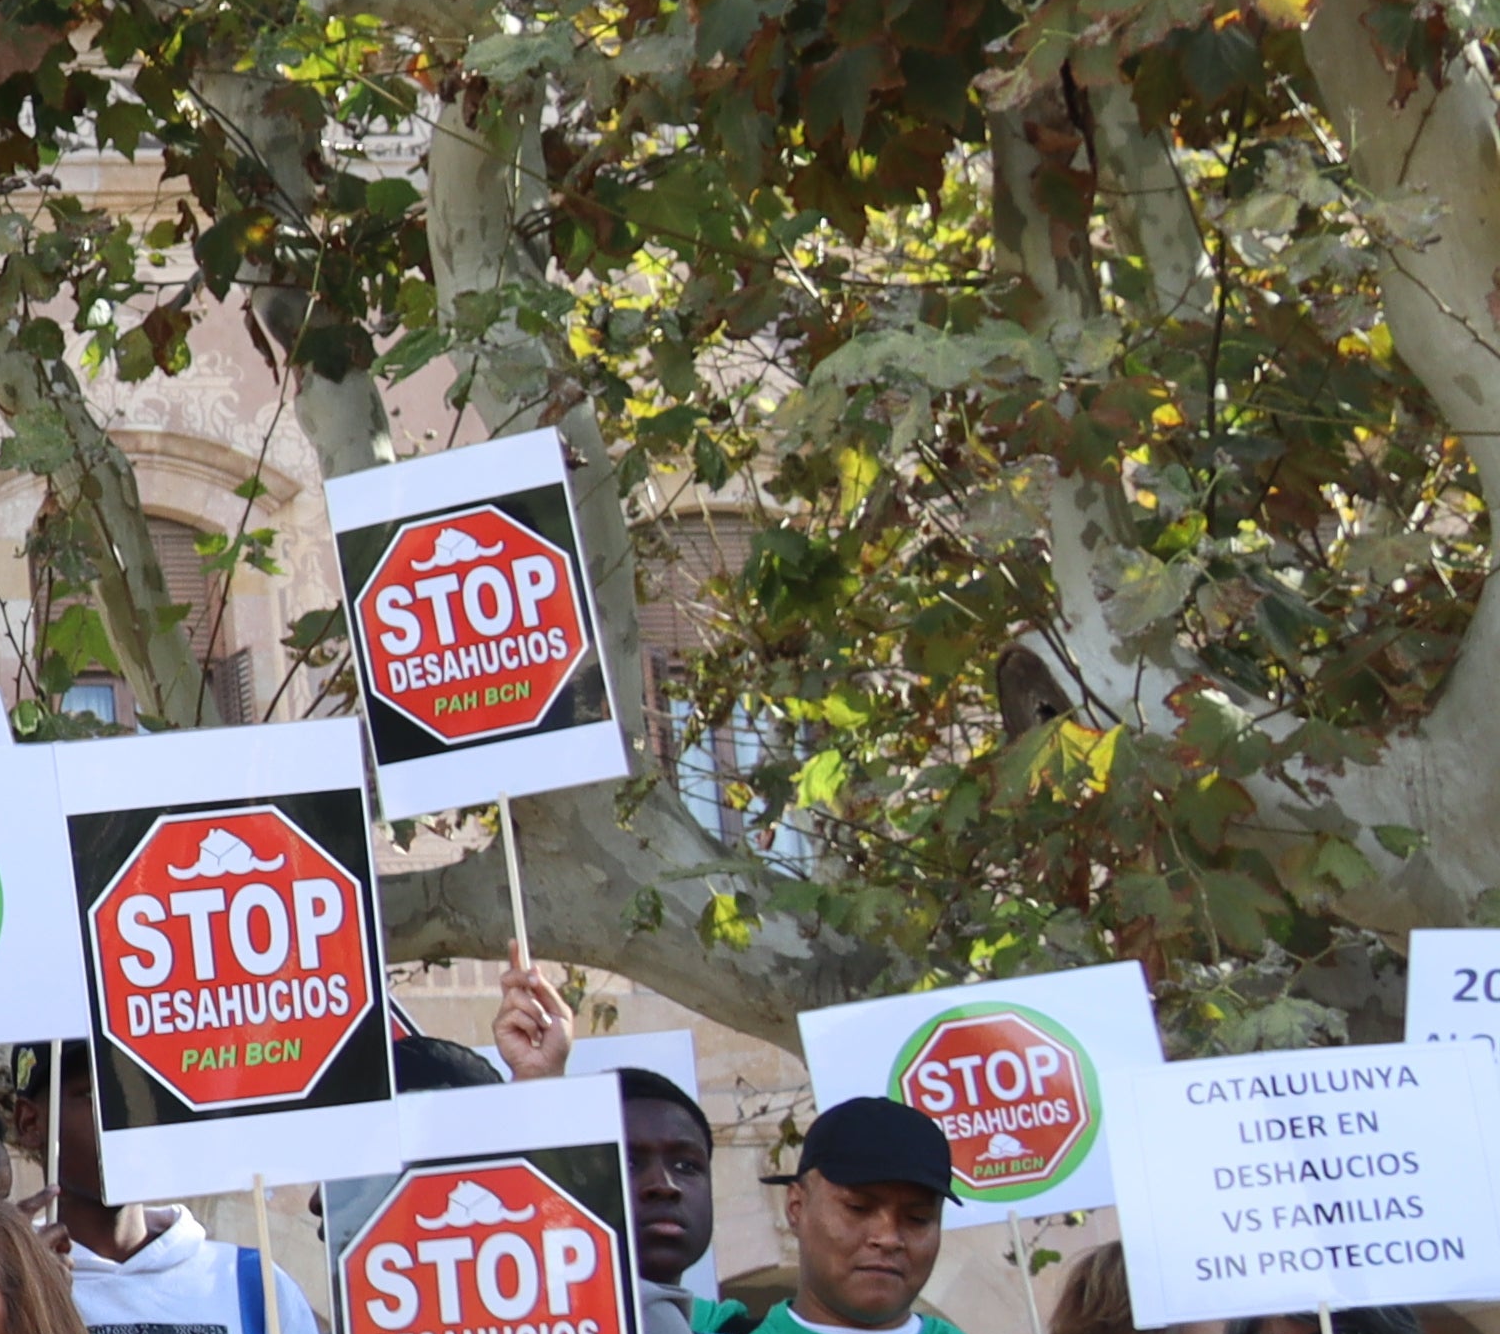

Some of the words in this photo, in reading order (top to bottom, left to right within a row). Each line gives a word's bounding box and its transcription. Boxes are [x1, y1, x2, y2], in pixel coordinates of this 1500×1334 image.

[374, 553, 557, 656] STOP
[386, 626, 568, 694] DESAHUCIOS
[434, 688, 477, 716] PAH
[485, 681, 531, 707] BCN
[115, 877, 344, 988] STOP
[126, 973, 349, 1037] DESAHUCIOS
[181, 1048, 236, 1072] PAH
[245, 1038, 301, 1066] BCN
[920, 1050, 1060, 1113] STOP
[1186, 1064, 1419, 1105] CATALULUNYA
[1238, 1115, 1328, 1145] LIDER
[1338, 1111, 1379, 1135] EN
[973, 1161, 1006, 1178] PAH
[1010, 1156, 1045, 1174] BCN
[1214, 1151, 1420, 1190] DESHAUCIOS
[1222, 1208, 1263, 1234] VS
[1272, 1194, 1424, 1231] FAMILIAS
[365, 1227, 597, 1330] STOP
[1196, 1252, 1248, 1281] SIN
[1258, 1237, 1466, 1275] PROTECCION
